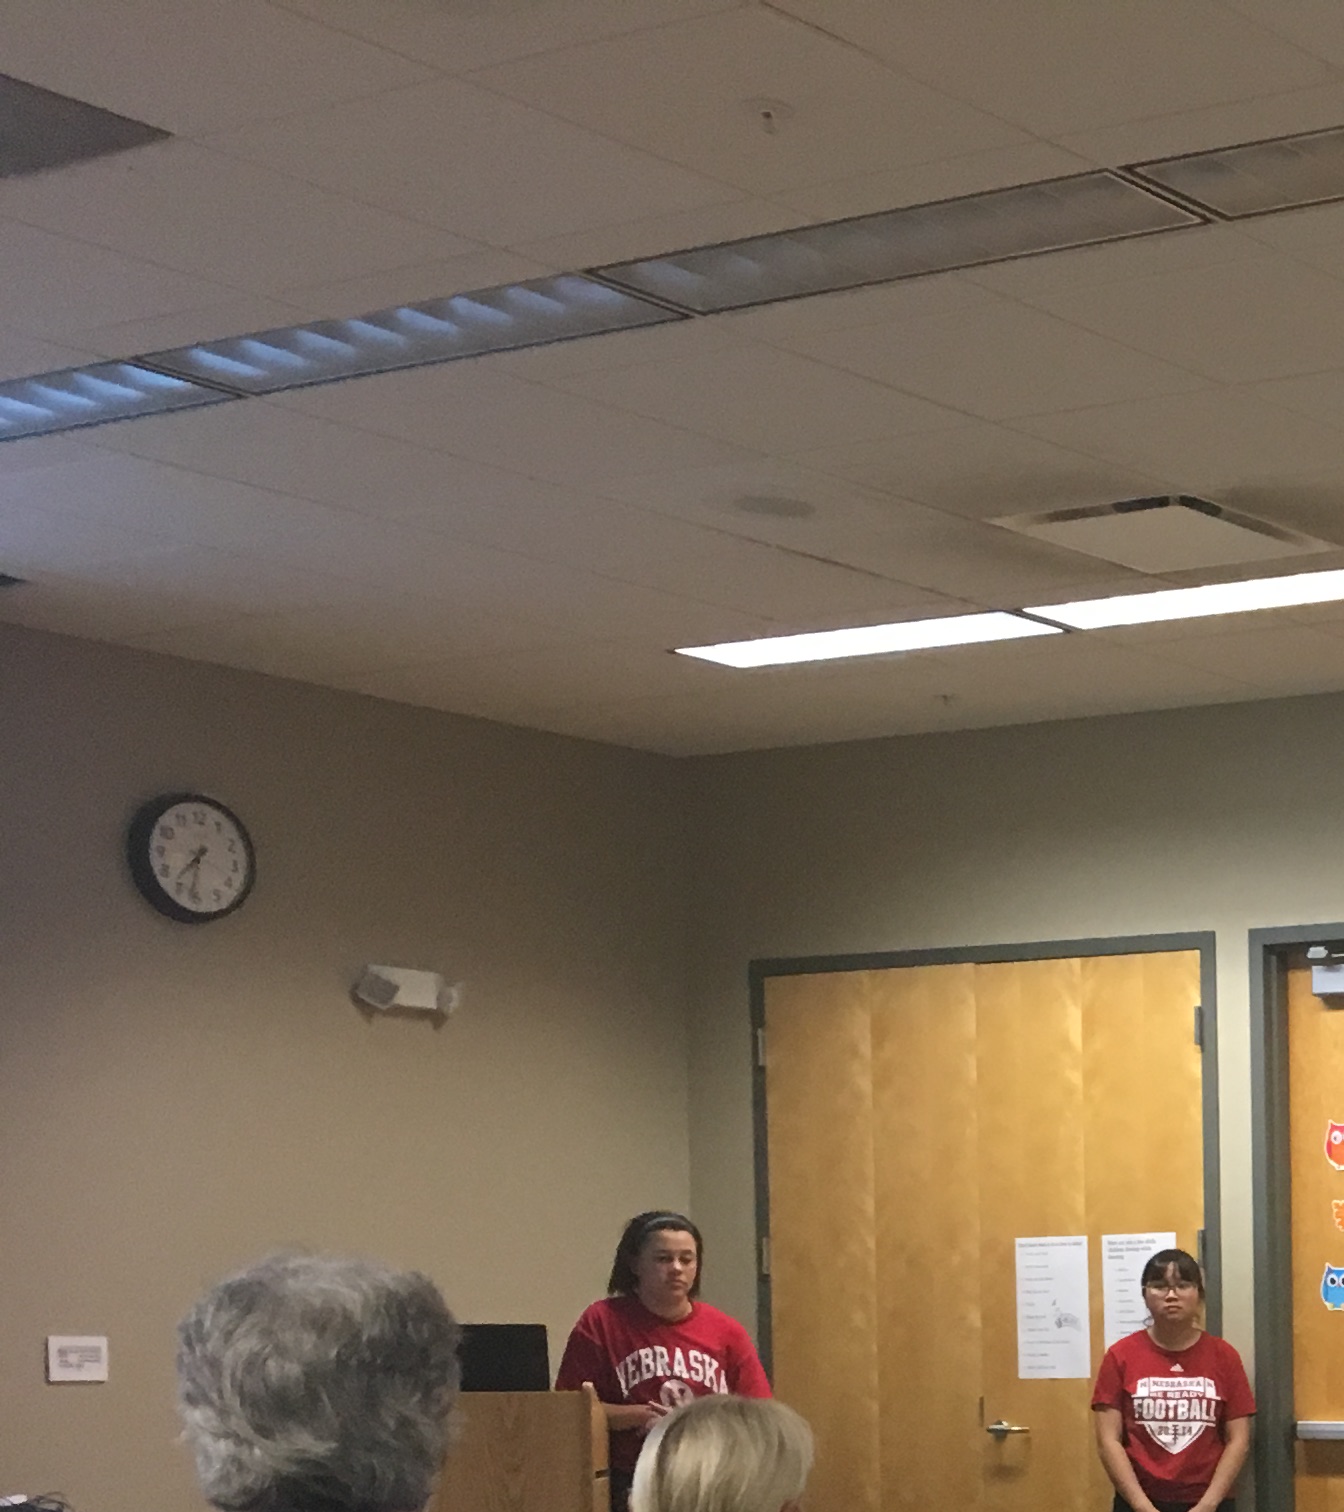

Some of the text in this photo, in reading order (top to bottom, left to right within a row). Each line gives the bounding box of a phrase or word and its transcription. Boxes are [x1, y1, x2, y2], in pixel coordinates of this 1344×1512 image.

[192, 811, 207, 825] 12
[615, 1345, 729, 1399] NEBRASKA
[1133, 1399, 1216, 1421] FOOTBALL
